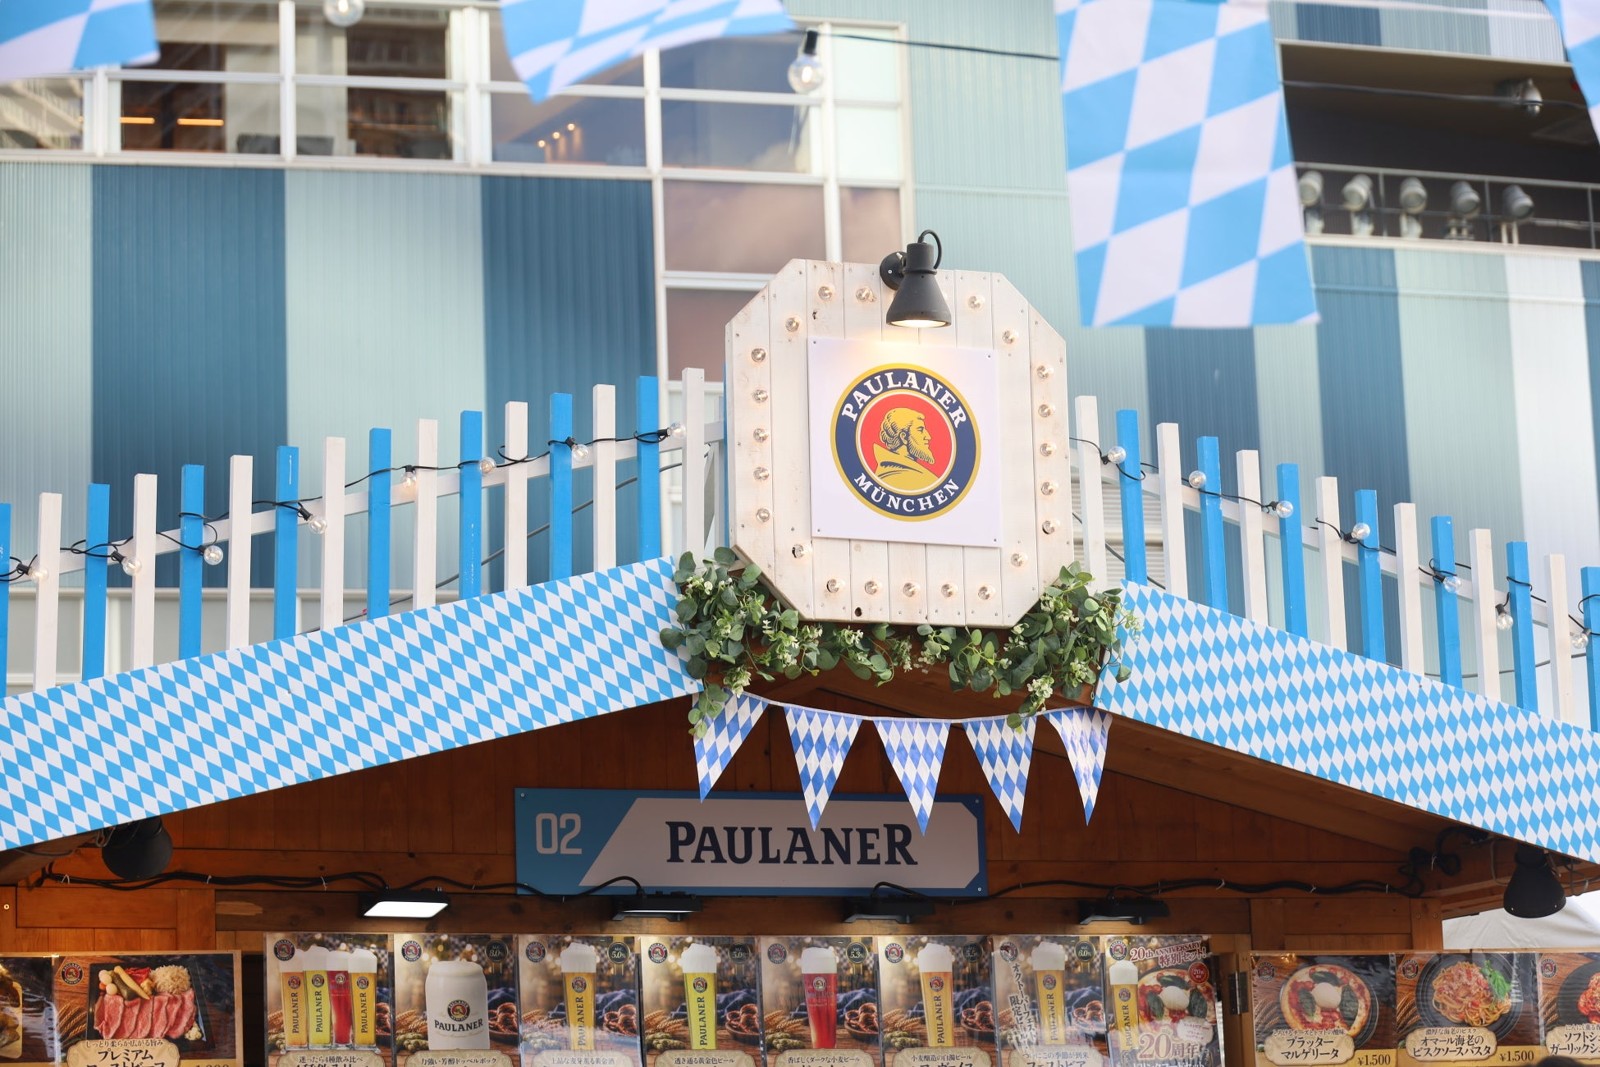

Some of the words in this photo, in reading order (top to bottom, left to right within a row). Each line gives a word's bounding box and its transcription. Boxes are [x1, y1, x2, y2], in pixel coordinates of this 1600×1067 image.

[842, 371, 967, 428] PAULANER
[854, 472, 960, 512] MÜNCHEN
[535, 812, 583, 855] 02
[665, 821, 919, 866] PAULANER
[291, 992, 299, 1034] PAULANER
[360, 992, 368, 1034] PAULANER
[434, 1019, 484, 1032] PAULANER
[577, 996, 585, 1046] PAULANER
[700, 996, 708, 1046] PAULANER
[933, 995, 945, 1044] PAULANER
[97, 1048, 154, 1062] プレミアム
[1280, 1047, 1339, 1060] マルゲリータ
[1357, 1053, 1391, 1066] ¥1,500
[1413, 1045, 1492, 1057] ビスクソースパスタ
[1420, 1034, 1485, 1046] オマール海老の
[1499, 1050, 1535, 1063] ¥1,500
